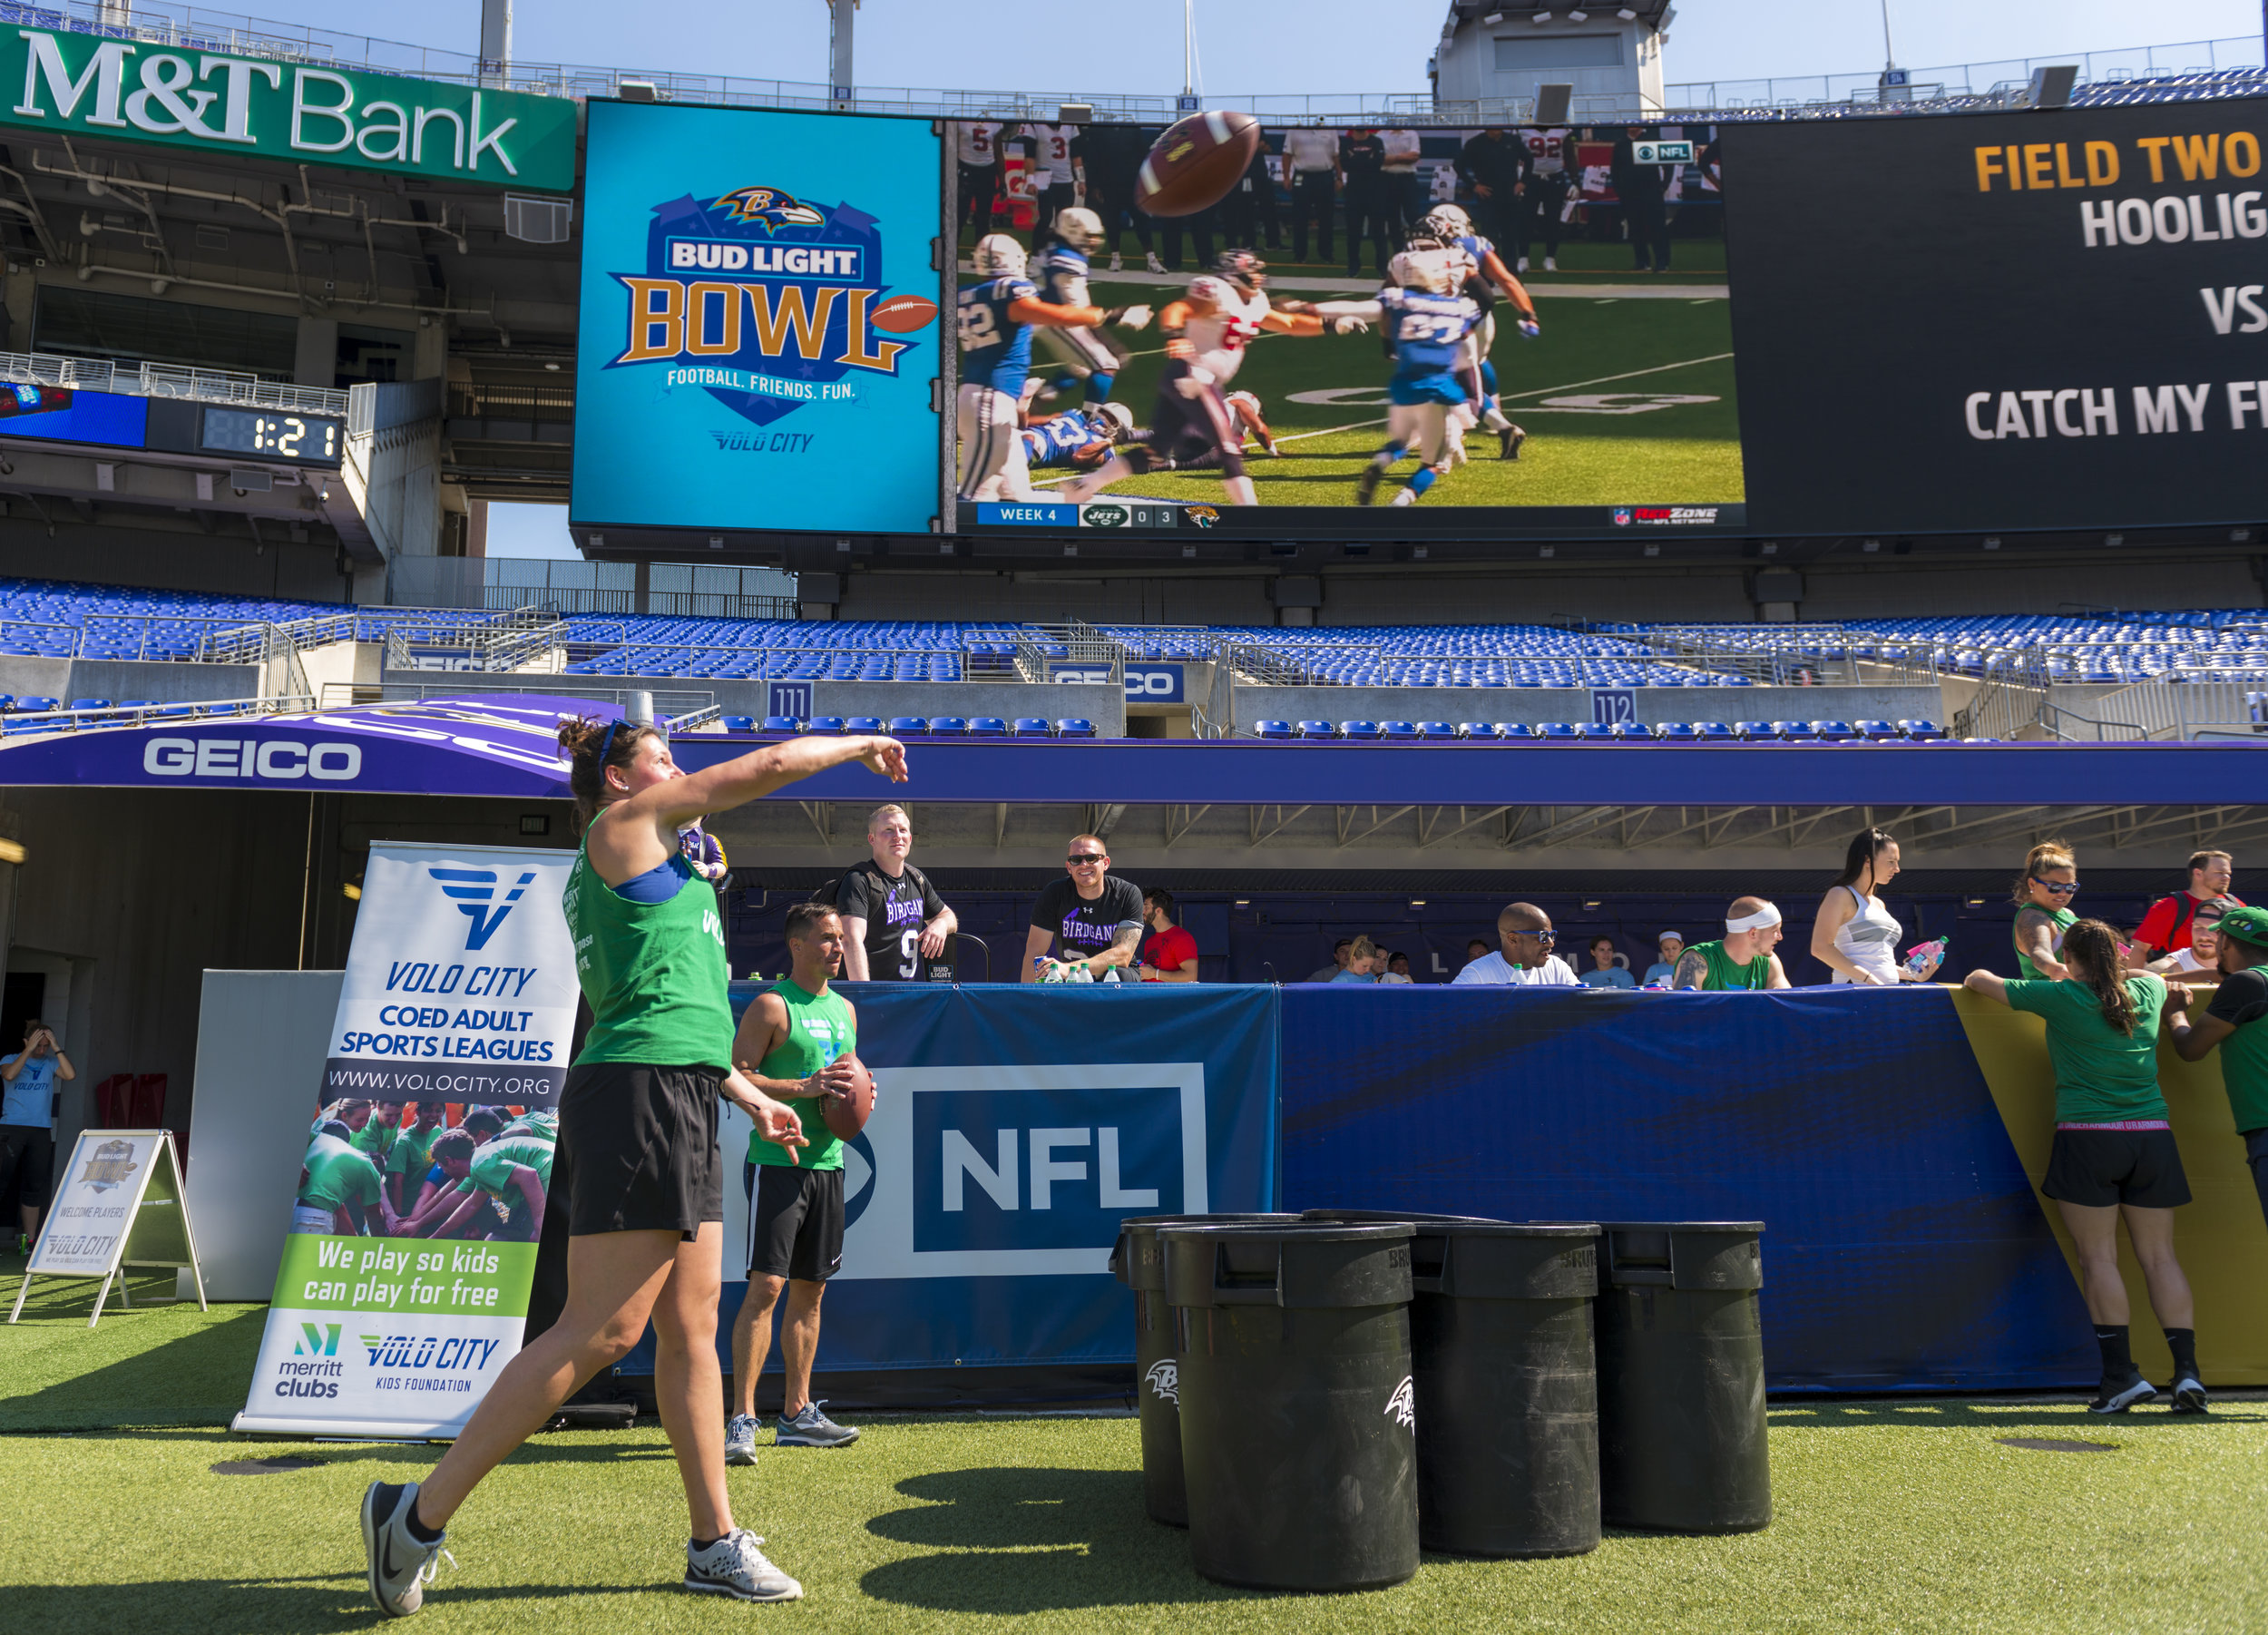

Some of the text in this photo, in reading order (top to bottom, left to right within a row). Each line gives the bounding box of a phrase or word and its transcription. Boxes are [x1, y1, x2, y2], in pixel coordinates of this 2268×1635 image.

[13, 30, 519, 177] M&T Bank
[973, 128, 989, 152] 5
[1051, 136, 1066, 160] 3
[1530, 137, 1561, 159] 92
[1659, 144, 1689, 160] NFL
[1974, 131, 2263, 192] FIELD TWO
[2079, 191, 2268, 248] HOOLIG
[672, 242, 857, 276] BUD LIGHT
[2199, 285, 2268, 336] VS
[616, 277, 908, 373] BOWL
[668, 368, 855, 400] FOOTBALL. FRIENDS. FUN.
[1964, 387, 2119, 440] CATCH
[2132, 383, 2212, 436] MY
[709, 429, 816, 454] VOLO CITY
[1001, 508, 1057, 522] WEEK 4
[1088, 510, 1121, 521] JETS
[1138, 511, 1147, 524] 0
[1162, 511, 1169, 523] 3
[1055, 671, 1174, 695] GECO
[777, 686, 806, 718] 111
[1596, 693, 1631, 724] 112
[143, 737, 362, 781] GEICO
[899, 929, 919, 979] 9
[386, 961, 538, 998] VOLO CITY
[380, 1005, 533, 1033] COED ADULT
[339, 1032, 554, 1062] SPORTS LEAGUES
[14, 1082, 49, 1091] VOLO CITY
[328, 1070, 551, 1096] WWW.VOLOCITY.ORG
[83, 1160, 130, 1181] BOWL
[942, 1125, 1158, 1212] NFL
[60, 1206, 125, 1219] WELCOME PLAYERS
[48, 1235, 118, 1256] VOLO CITY
[318, 1240, 500, 1276] We play so kids
[1388, 1248, 1410, 1269] BRU
[303, 1275, 500, 1308] can play for free
[359, 1335, 501, 1371] VOLO CITY
[279, 1359, 344, 1377] merritt
[275, 1377, 339, 1399] clubs
[376, 1376, 471, 1393] KIDS FOUNDATION
